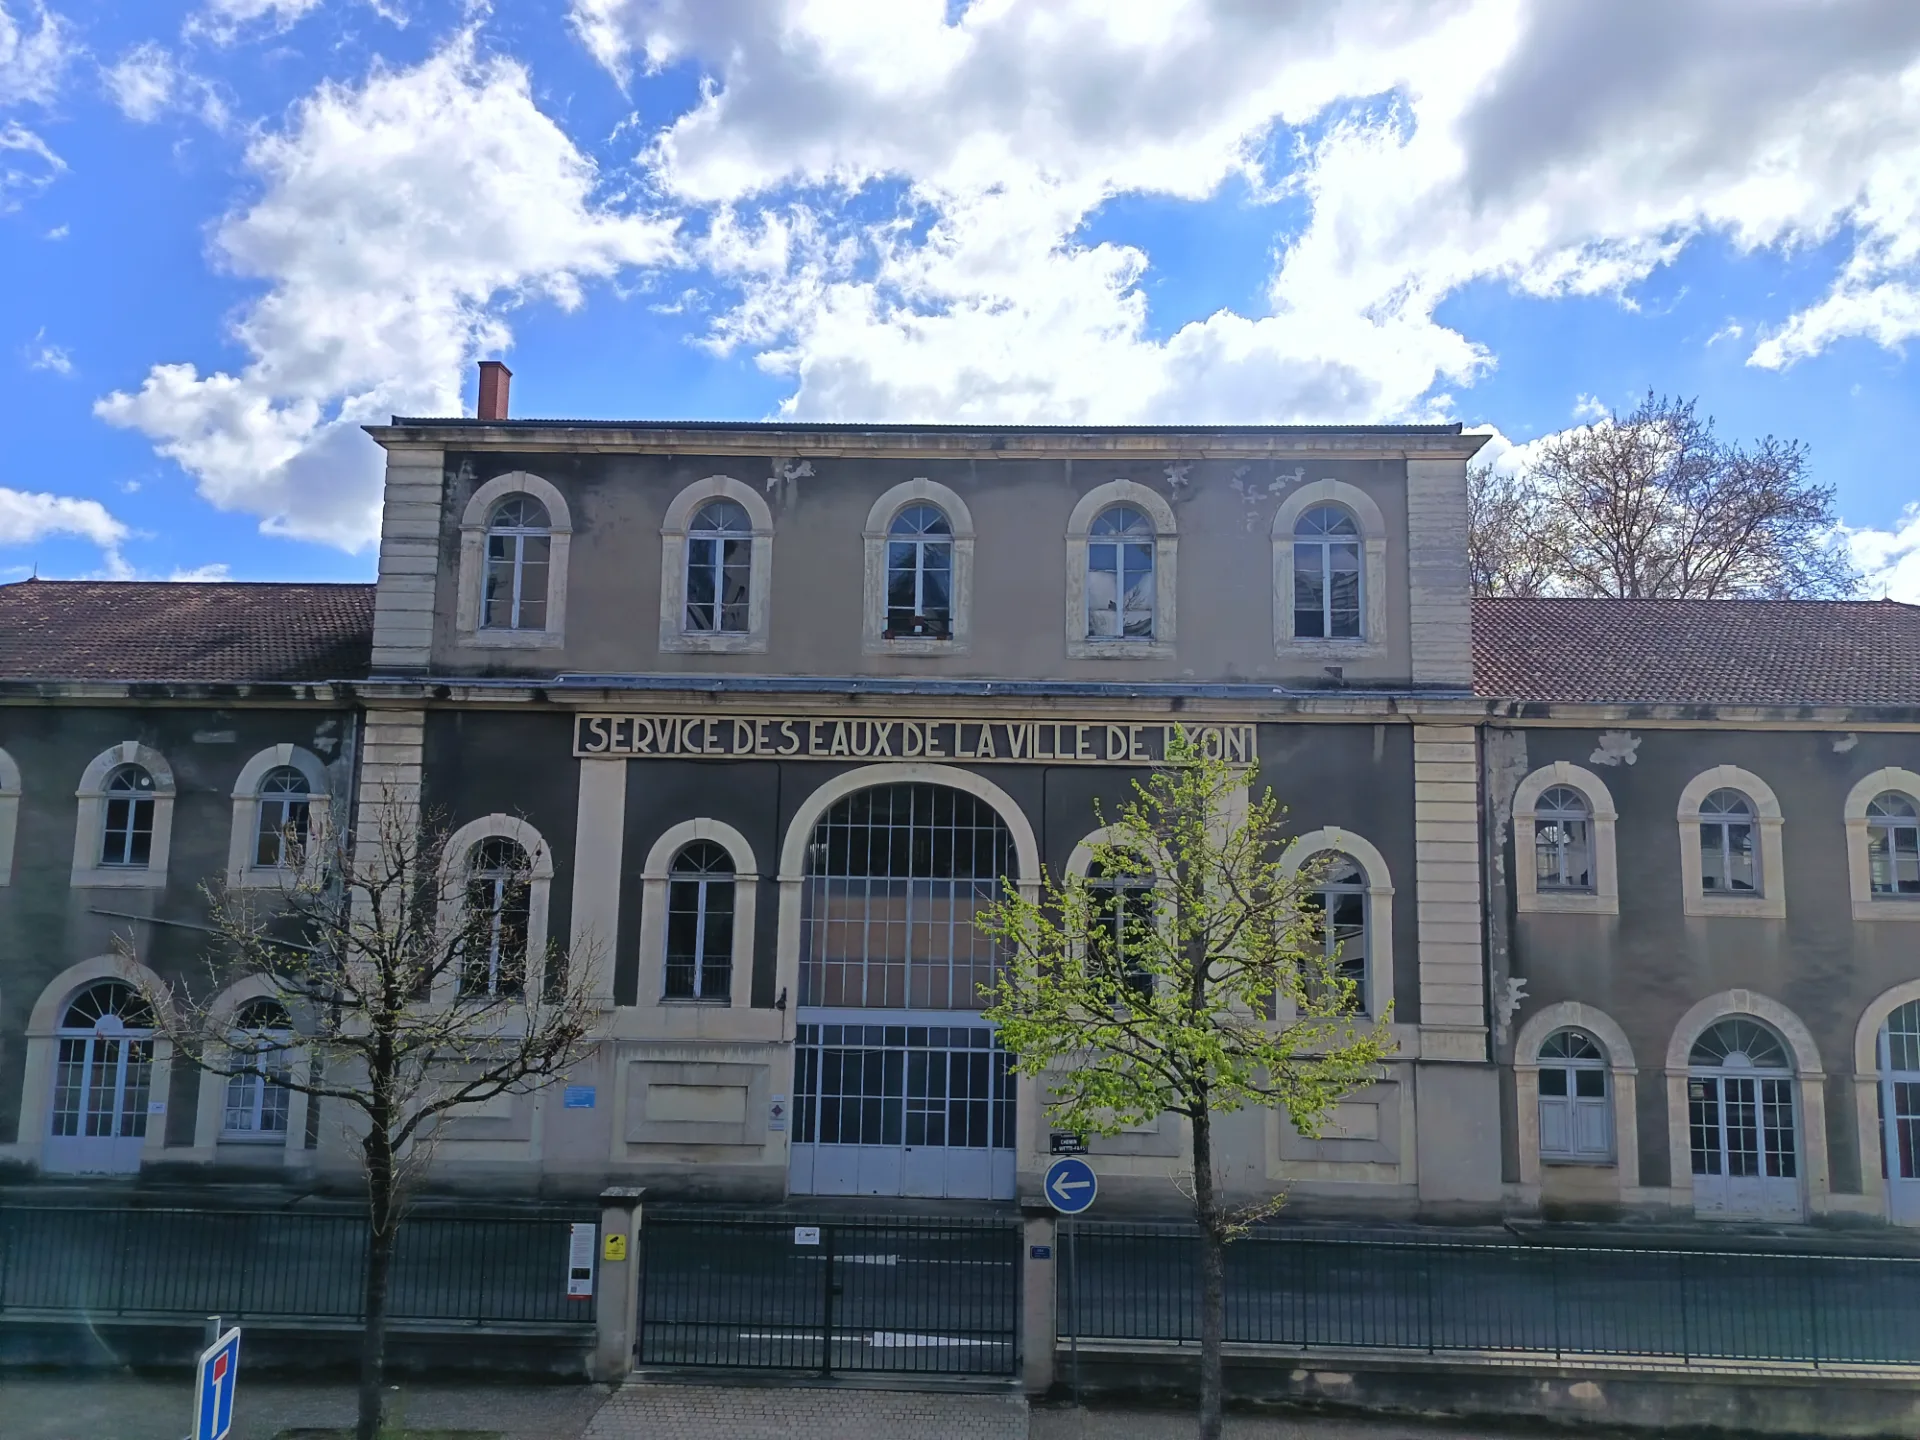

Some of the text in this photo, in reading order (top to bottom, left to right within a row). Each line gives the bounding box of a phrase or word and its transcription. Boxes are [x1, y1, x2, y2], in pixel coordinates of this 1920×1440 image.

[585, 717, 1245, 762] SERVICE DES EAUX DE LA VILLE DE LYON
